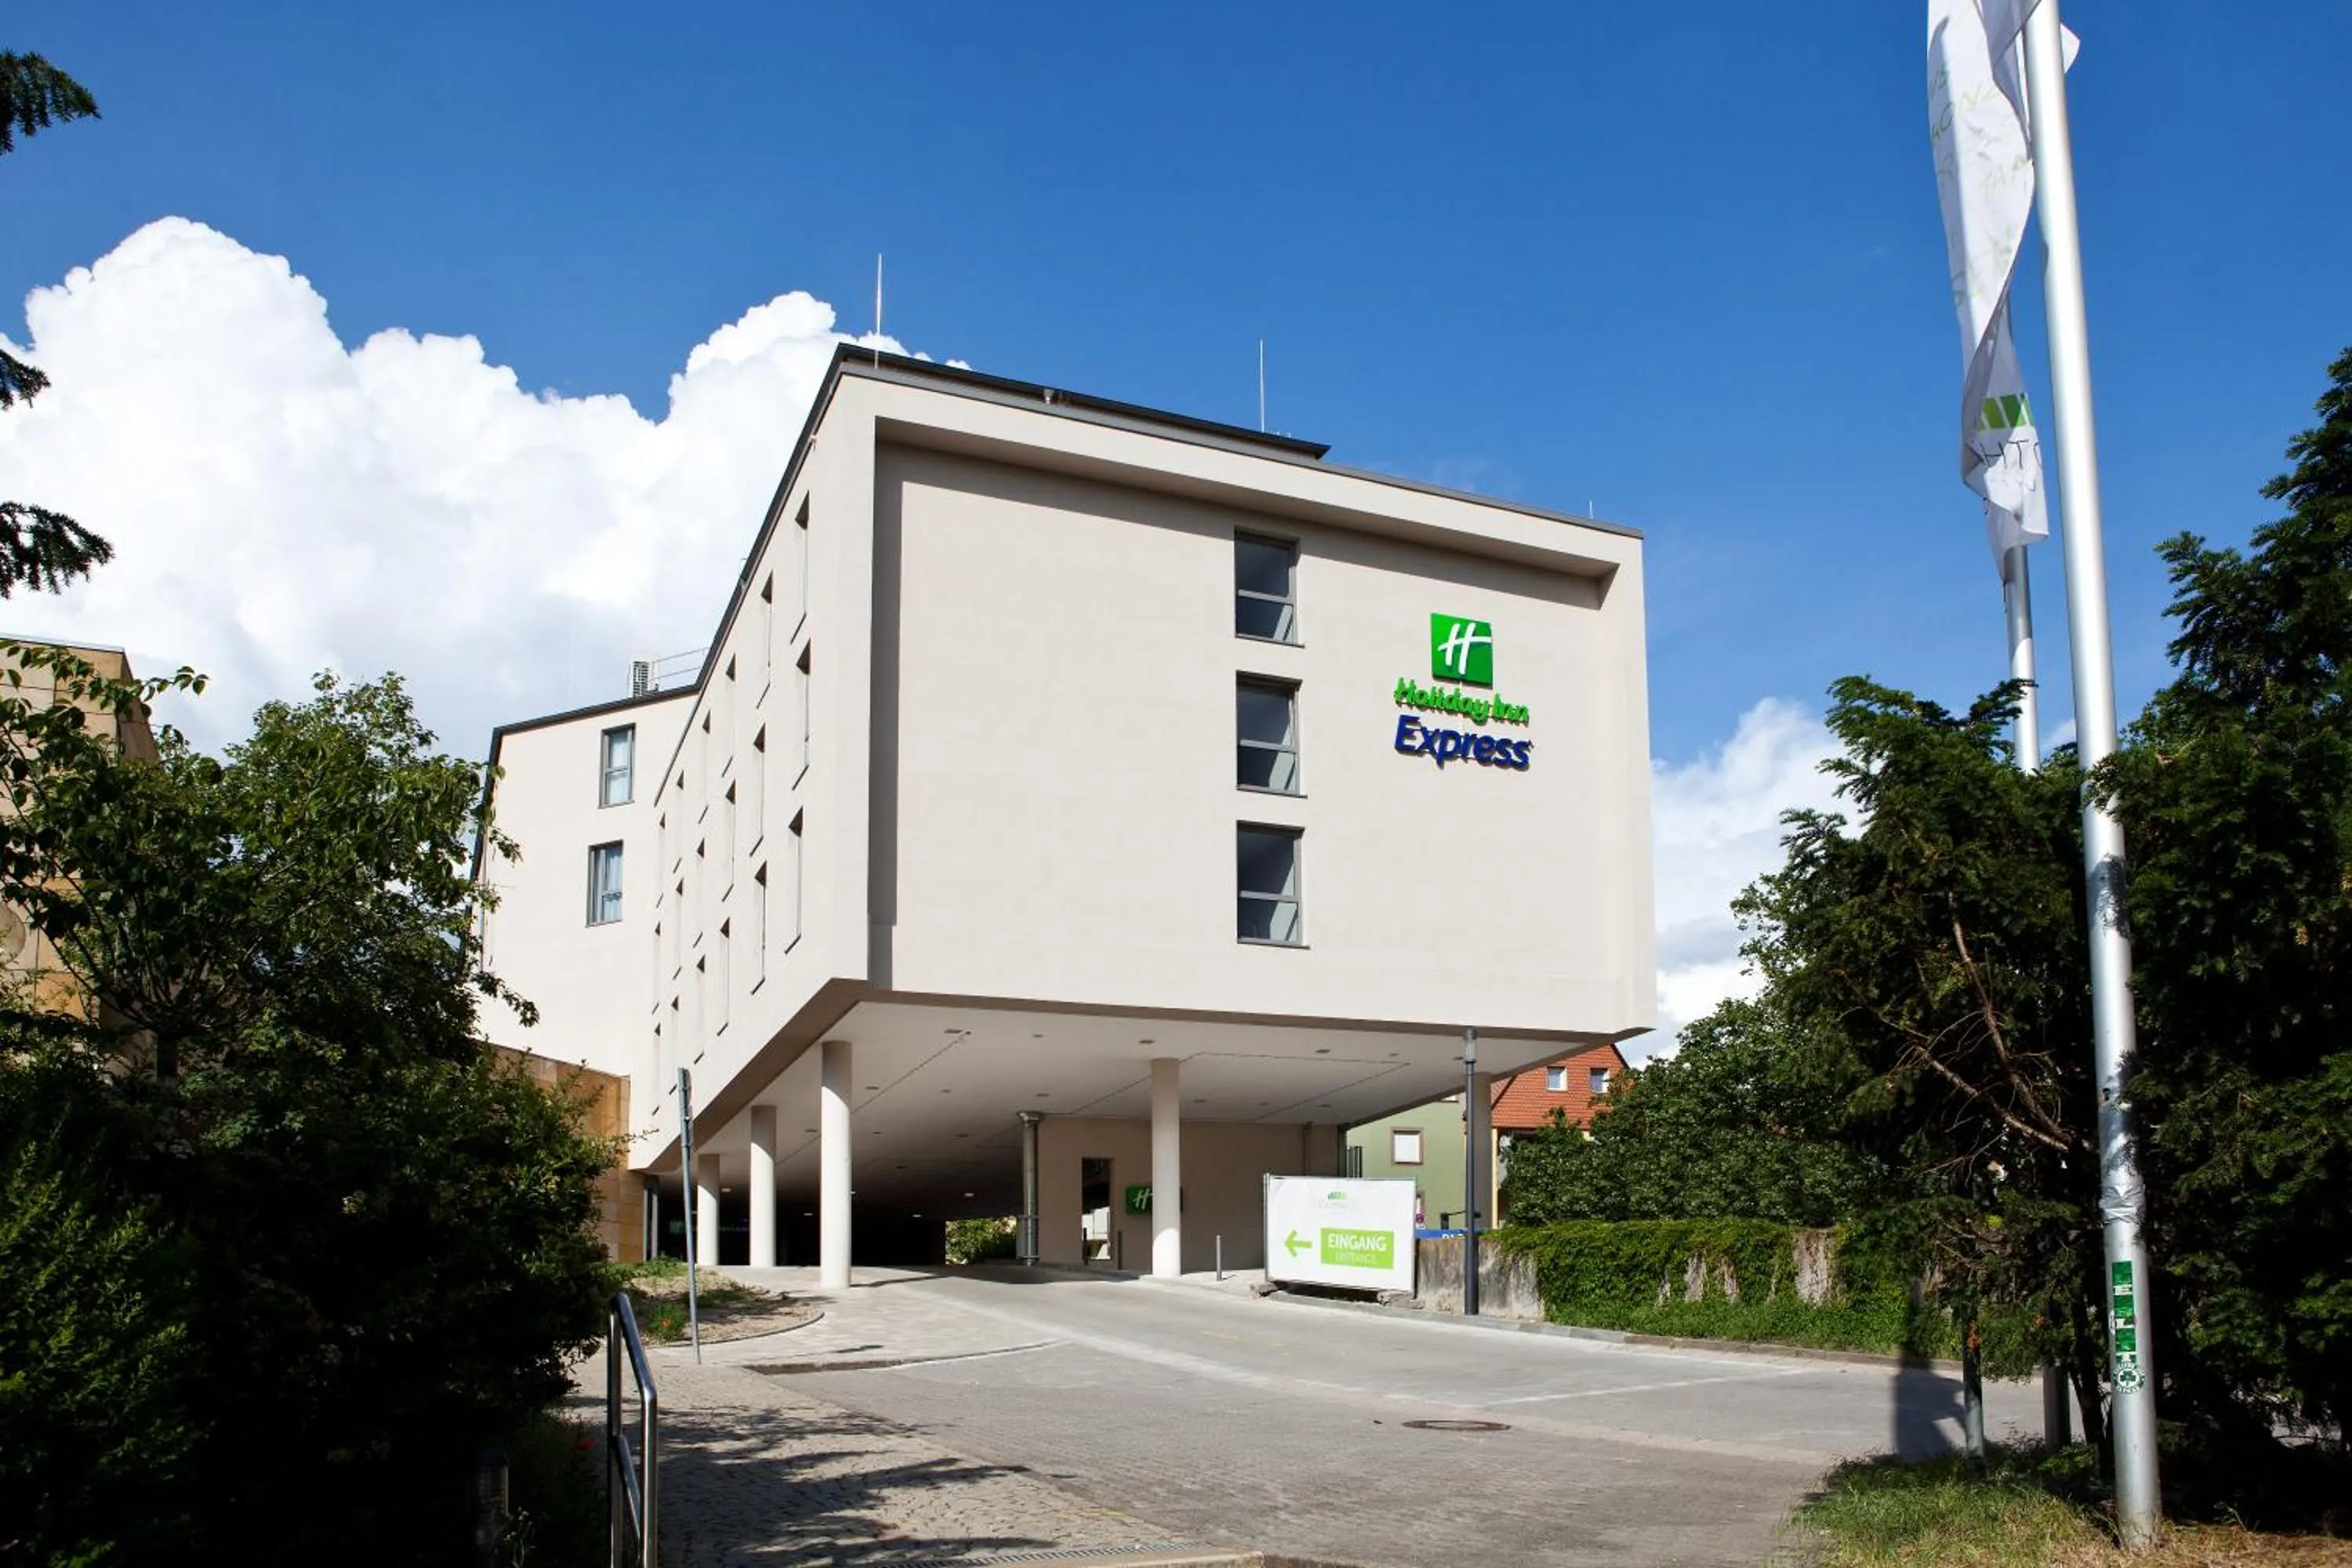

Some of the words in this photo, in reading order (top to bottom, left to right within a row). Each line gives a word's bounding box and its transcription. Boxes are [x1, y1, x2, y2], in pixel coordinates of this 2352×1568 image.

[1394, 677, 1490, 725] Holiday
[1491, 692, 1530, 728] Inn
[1394, 713, 1531, 771] Express
[1327, 1233, 1386, 1252] EINGANG
